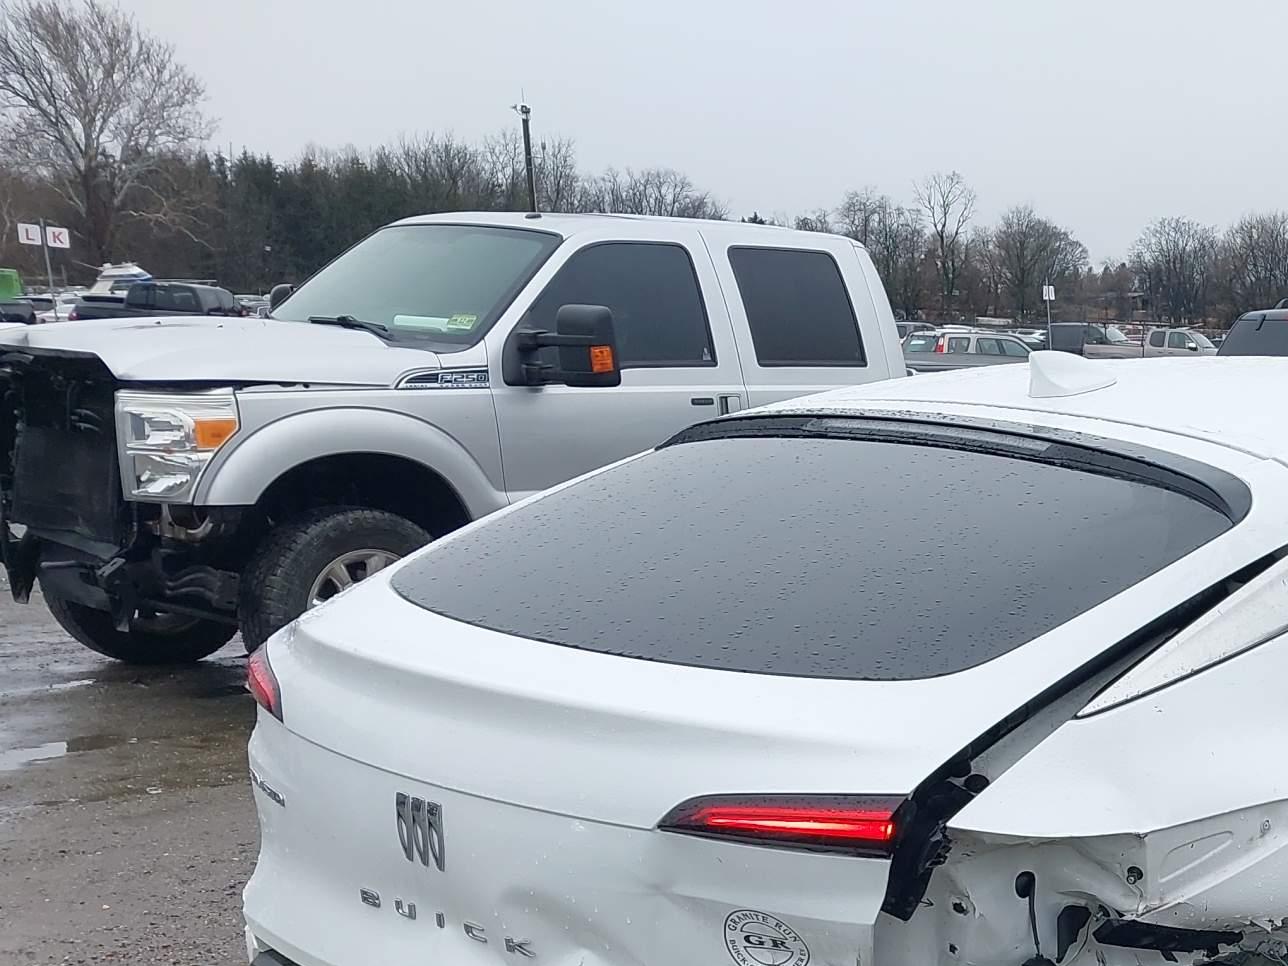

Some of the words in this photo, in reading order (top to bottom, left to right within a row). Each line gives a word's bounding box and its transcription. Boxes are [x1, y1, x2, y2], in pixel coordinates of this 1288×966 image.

[25, 228, 36, 241] L
[52, 231, 65, 244] K
[360, 887, 537, 958] BUICK
[727, 912, 770, 932] GRANITE
[774, 921, 800, 943] RUN
[743, 934, 791, 950] GR
